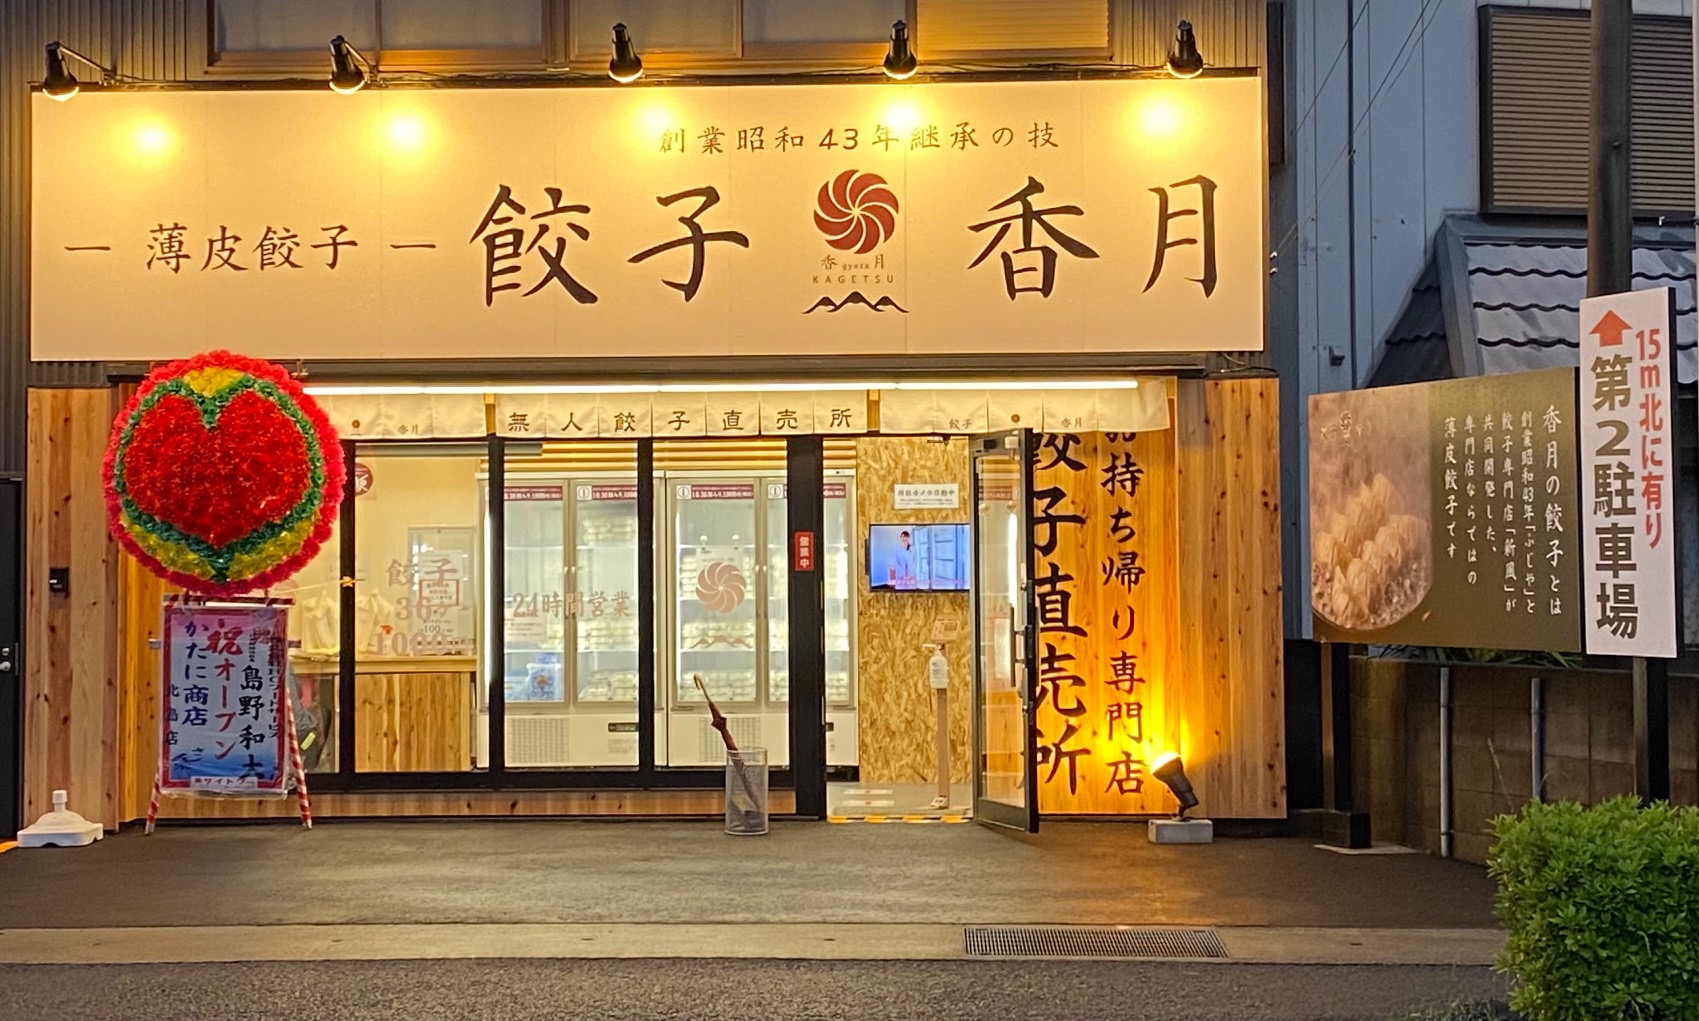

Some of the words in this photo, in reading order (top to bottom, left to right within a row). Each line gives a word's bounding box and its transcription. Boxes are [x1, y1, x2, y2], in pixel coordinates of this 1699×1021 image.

[659, 121, 1060, 155] 創業昭和43年継承の技
[145, 222, 358, 273] 薄皮餃子
[469, 184, 750, 306] 餃子
[967, 175, 1219, 302] 香月
[812, 275, 894, 284] KAGETSU
[507, 409, 852, 433] 無人餃子直売所
[948, 416, 973, 430] 餃子
[1061, 417, 1083, 428] 香月
[1635, 328, 1664, 550] 15m北に有り
[1443, 416, 1459, 559] 薄皮餃子です
[1463, 414, 1478, 585] 専門店ならではの
[1542, 404, 1564, 616] 香月の餃子とは
[1590, 353, 1640, 640] 第2駐車場
[207, 618, 243, 656] 祝
[512, 591, 633, 618] 24時間営業
[214, 658, 237, 761] オープン
